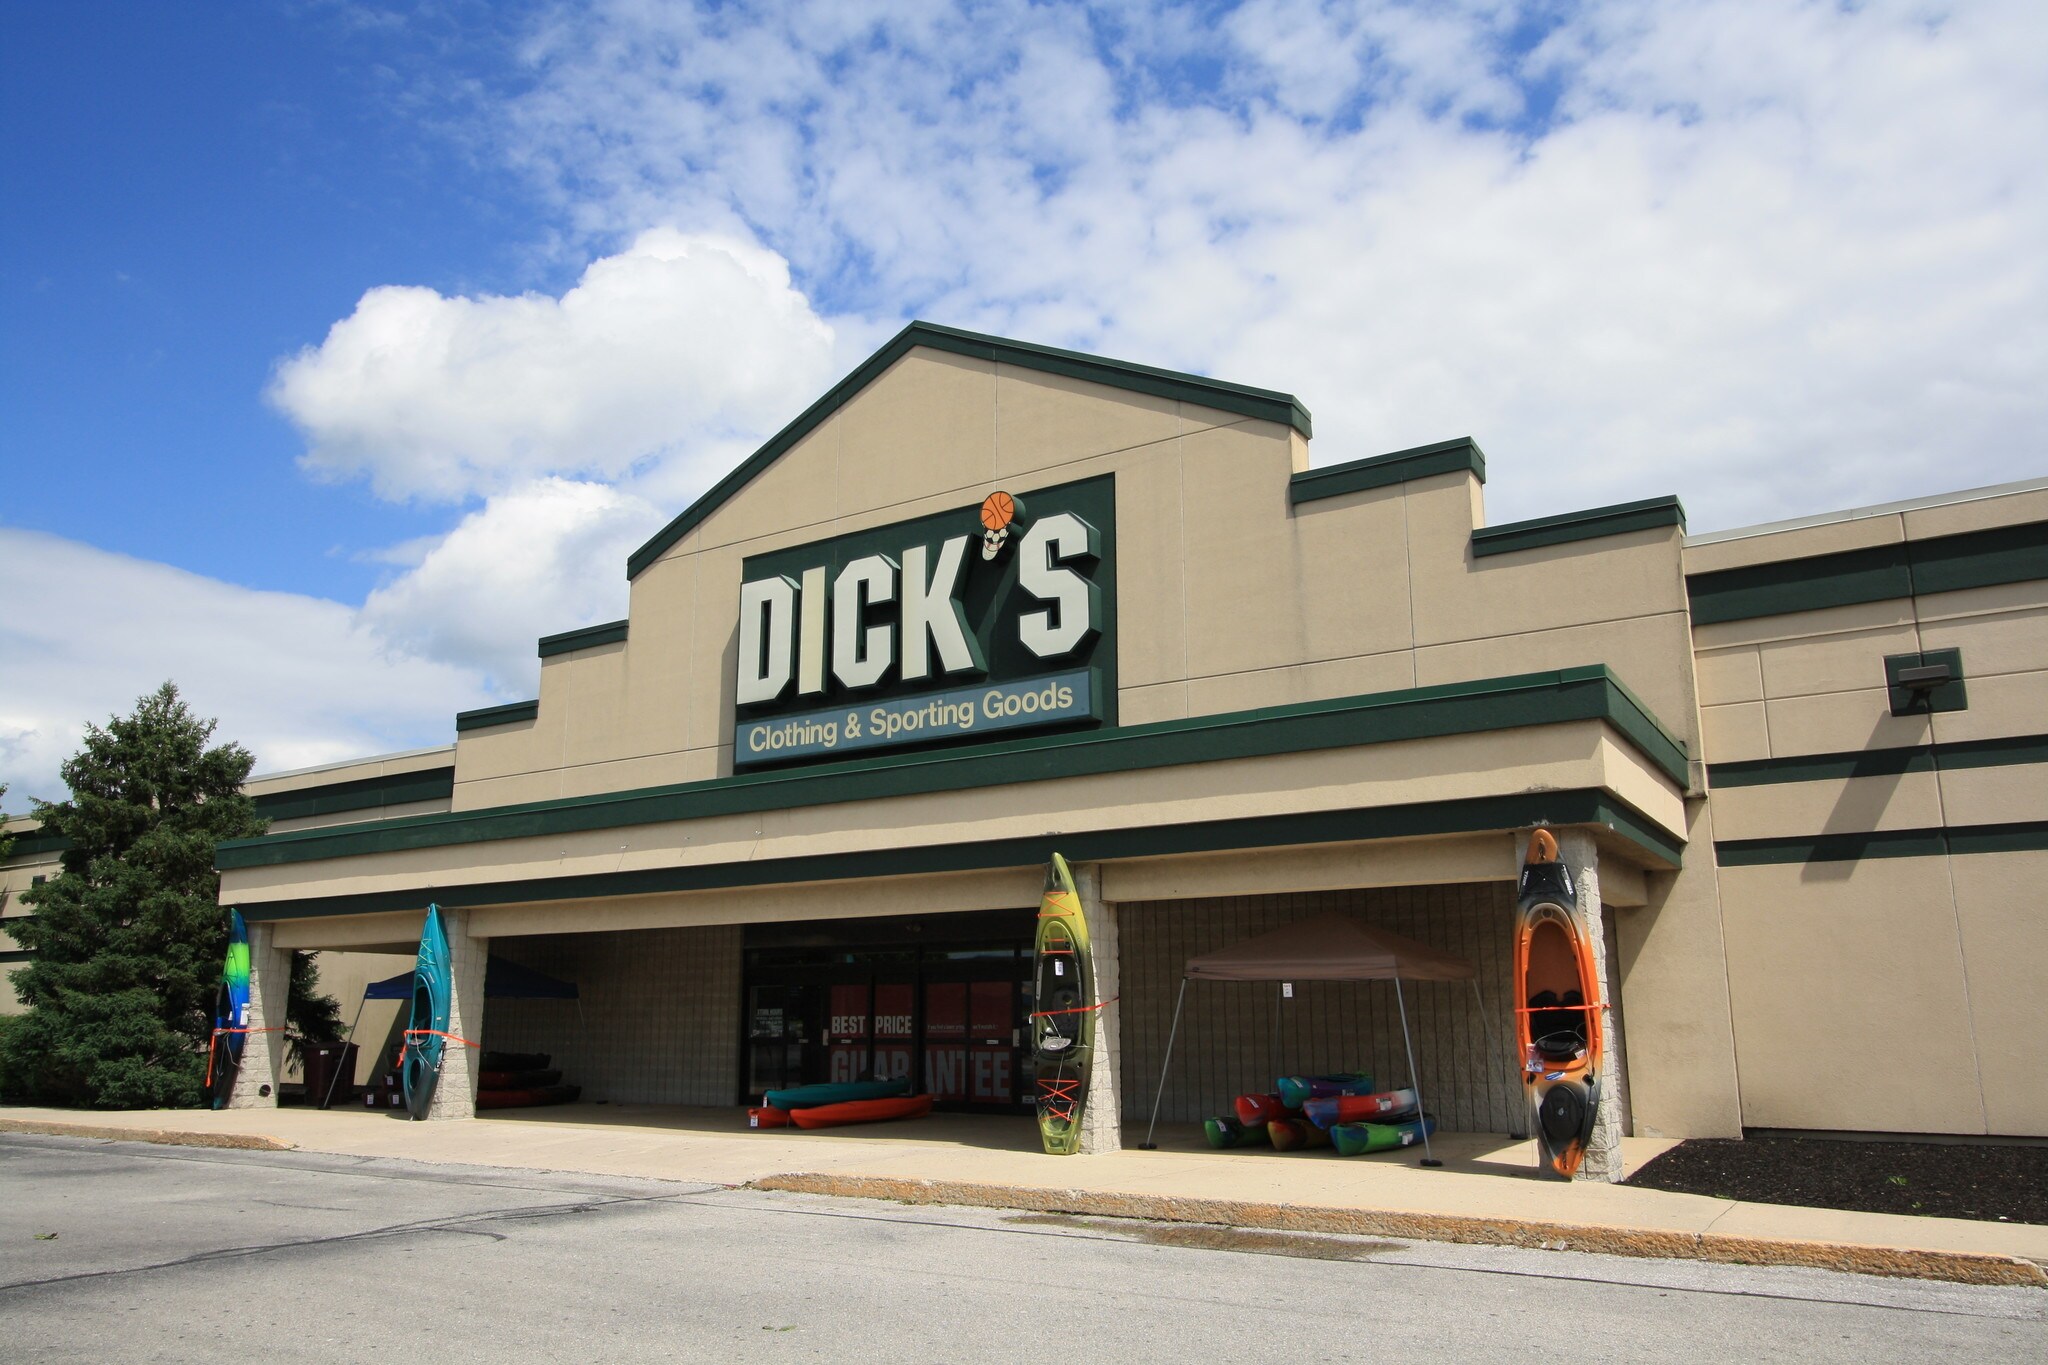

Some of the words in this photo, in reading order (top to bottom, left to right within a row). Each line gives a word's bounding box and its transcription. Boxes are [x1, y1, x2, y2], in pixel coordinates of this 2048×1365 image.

[737, 491, 1092, 705] DICK'S
[750, 719, 838, 752] Clothing
[844, 713, 861, 739] &
[869, 700, 975, 738] Sporting
[982, 682, 1074, 718] Goods
[831, 1015, 866, 1034] BEST
[874, 1015, 912, 1034] PRICE
